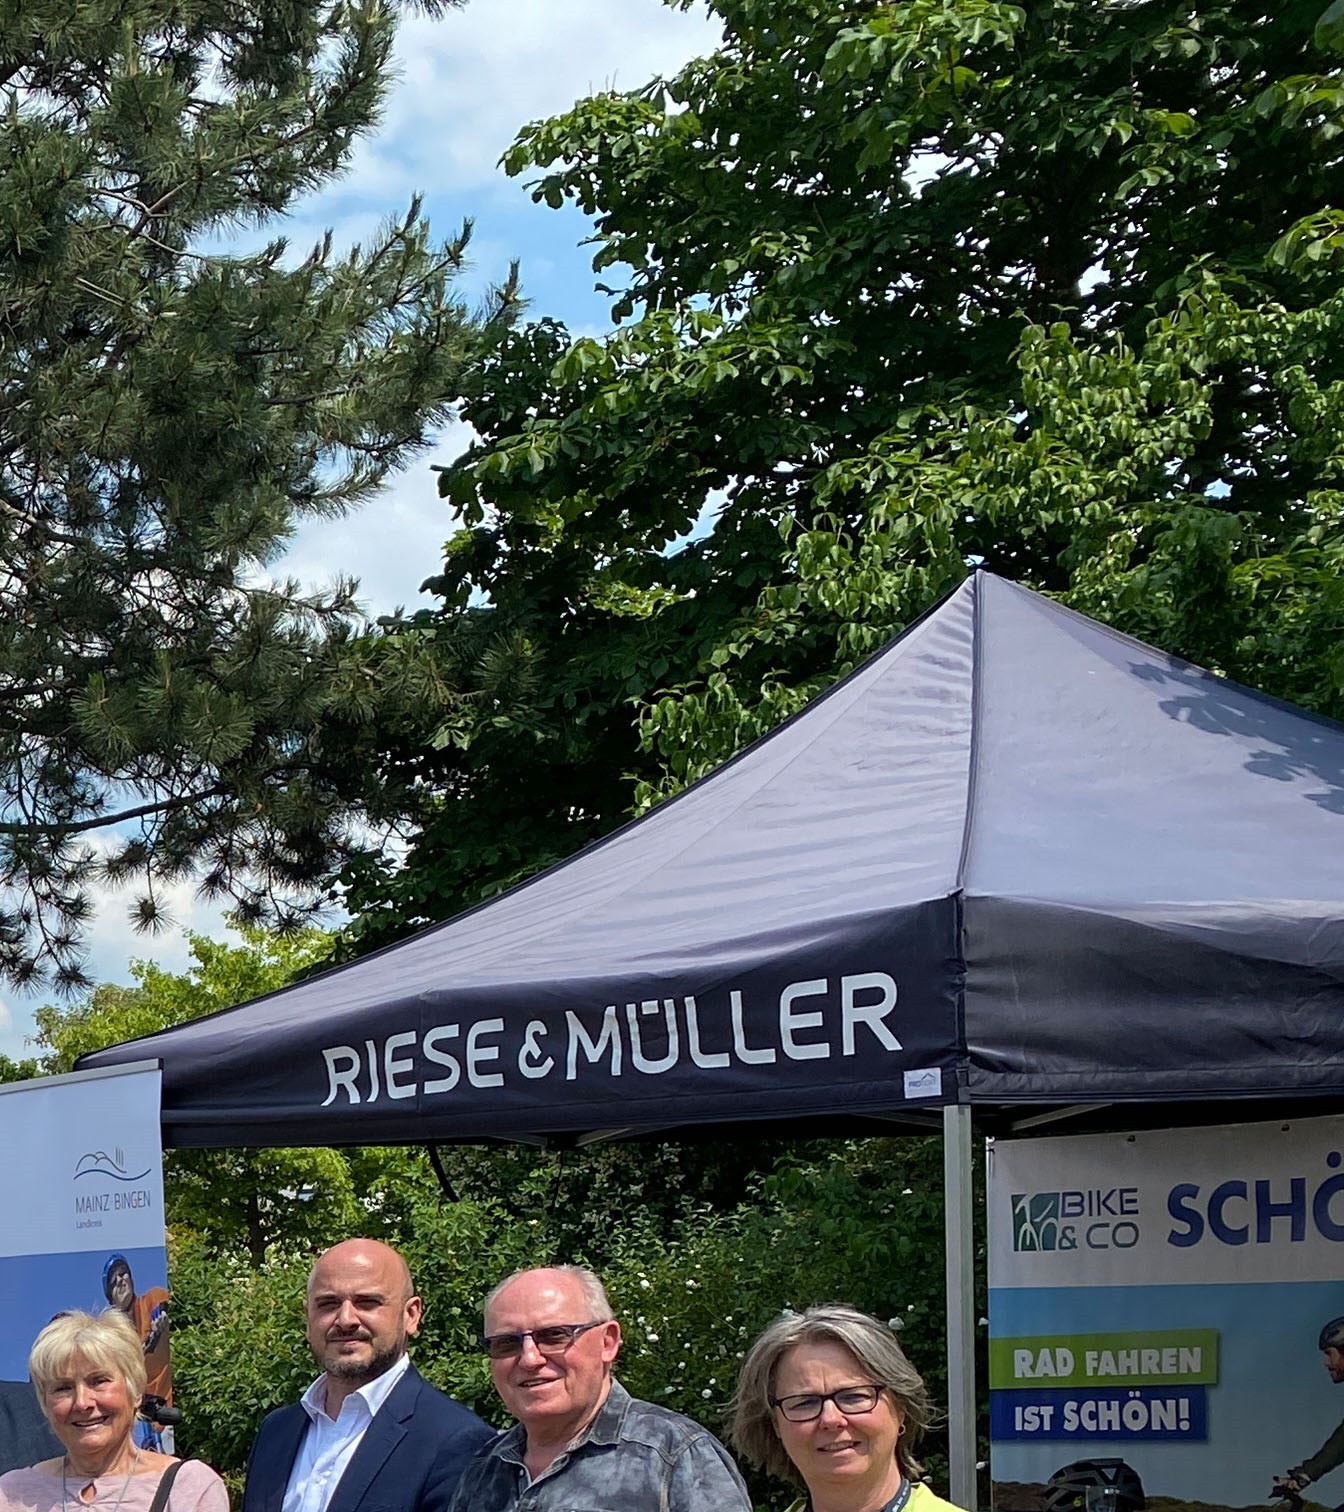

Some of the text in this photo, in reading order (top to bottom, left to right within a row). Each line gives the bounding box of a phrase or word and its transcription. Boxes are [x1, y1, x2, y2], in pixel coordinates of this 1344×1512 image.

[320, 1017, 505, 1107] RIESE
[565, 971, 903, 1081] MÜLLER
[75, 1191, 151, 1214] MAINZ BINGEN
[1061, 1187, 1140, 1218] BIKE
[1058, 1222, 1140, 1250] & CO
[1014, 1347, 1202, 1378] RAD FAHREN
[1015, 1390, 1190, 1432] IST SCHÖN!
